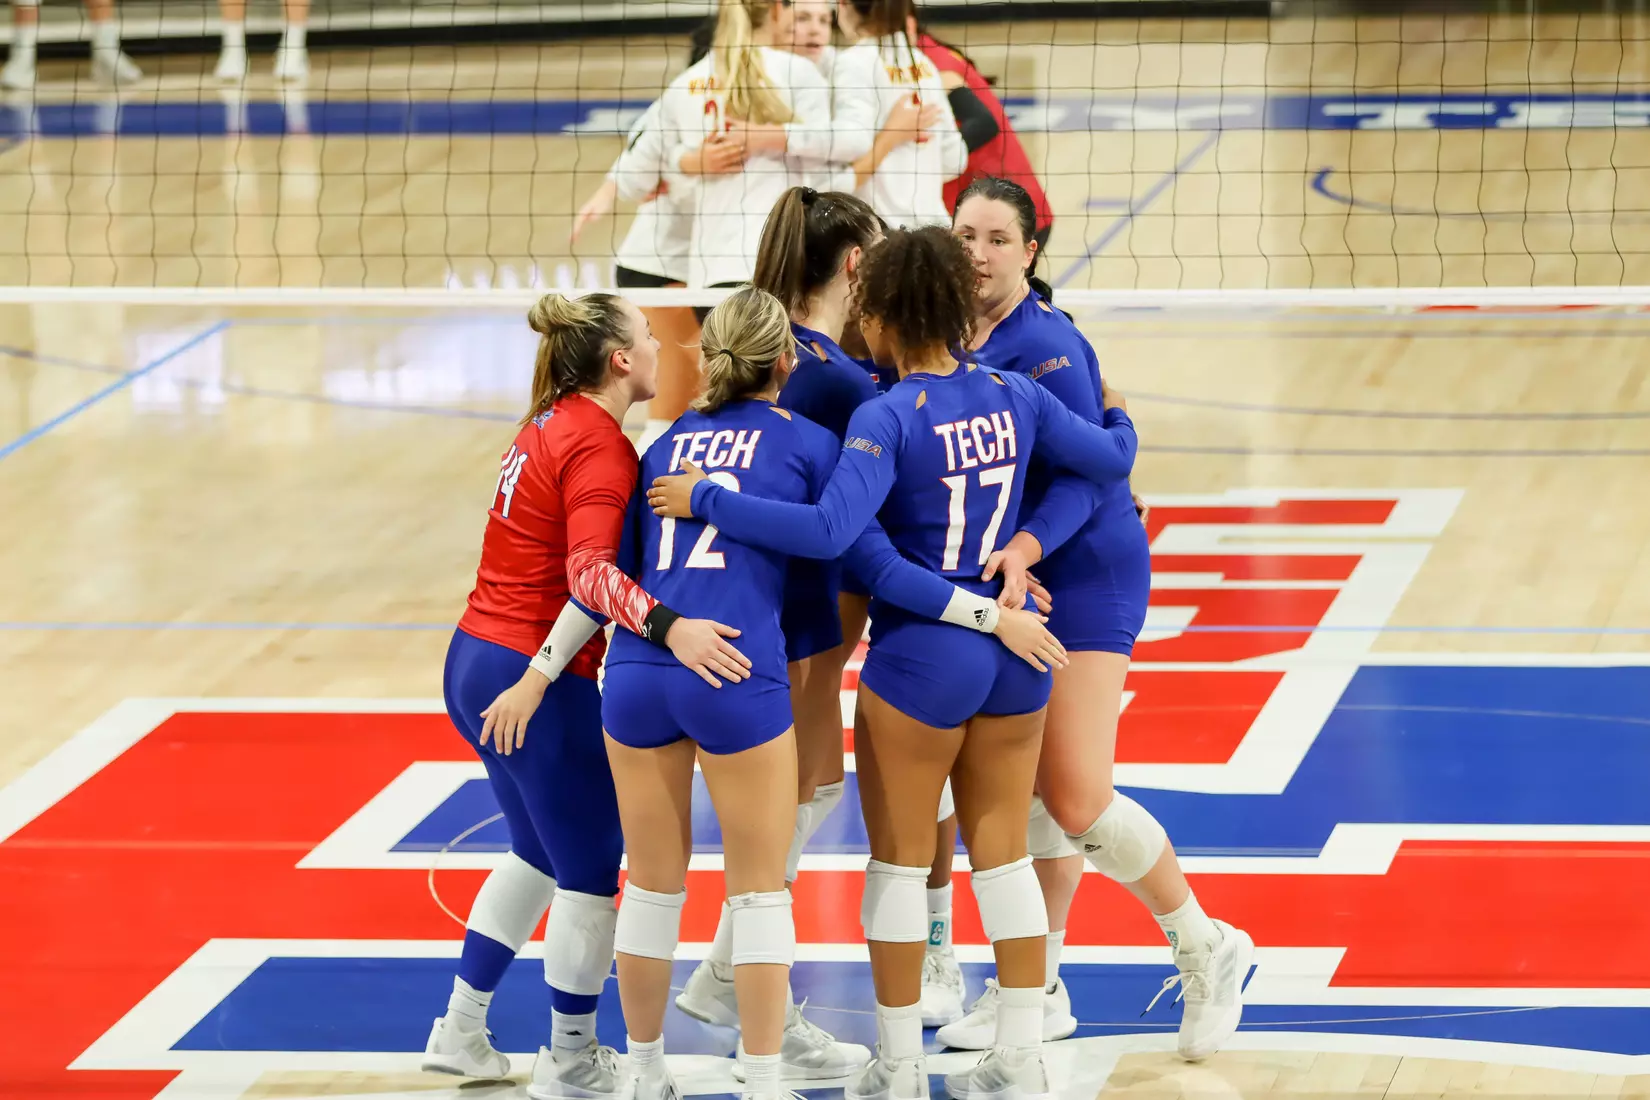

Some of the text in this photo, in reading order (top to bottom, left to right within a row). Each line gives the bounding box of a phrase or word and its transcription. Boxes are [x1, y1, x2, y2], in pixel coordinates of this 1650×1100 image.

[1031, 355, 1072, 380] USA
[668, 429, 763, 473] TECH
[845, 436, 883, 459] USA
[933, 410, 1017, 472] TECH
[939, 463, 1017, 571] 17
